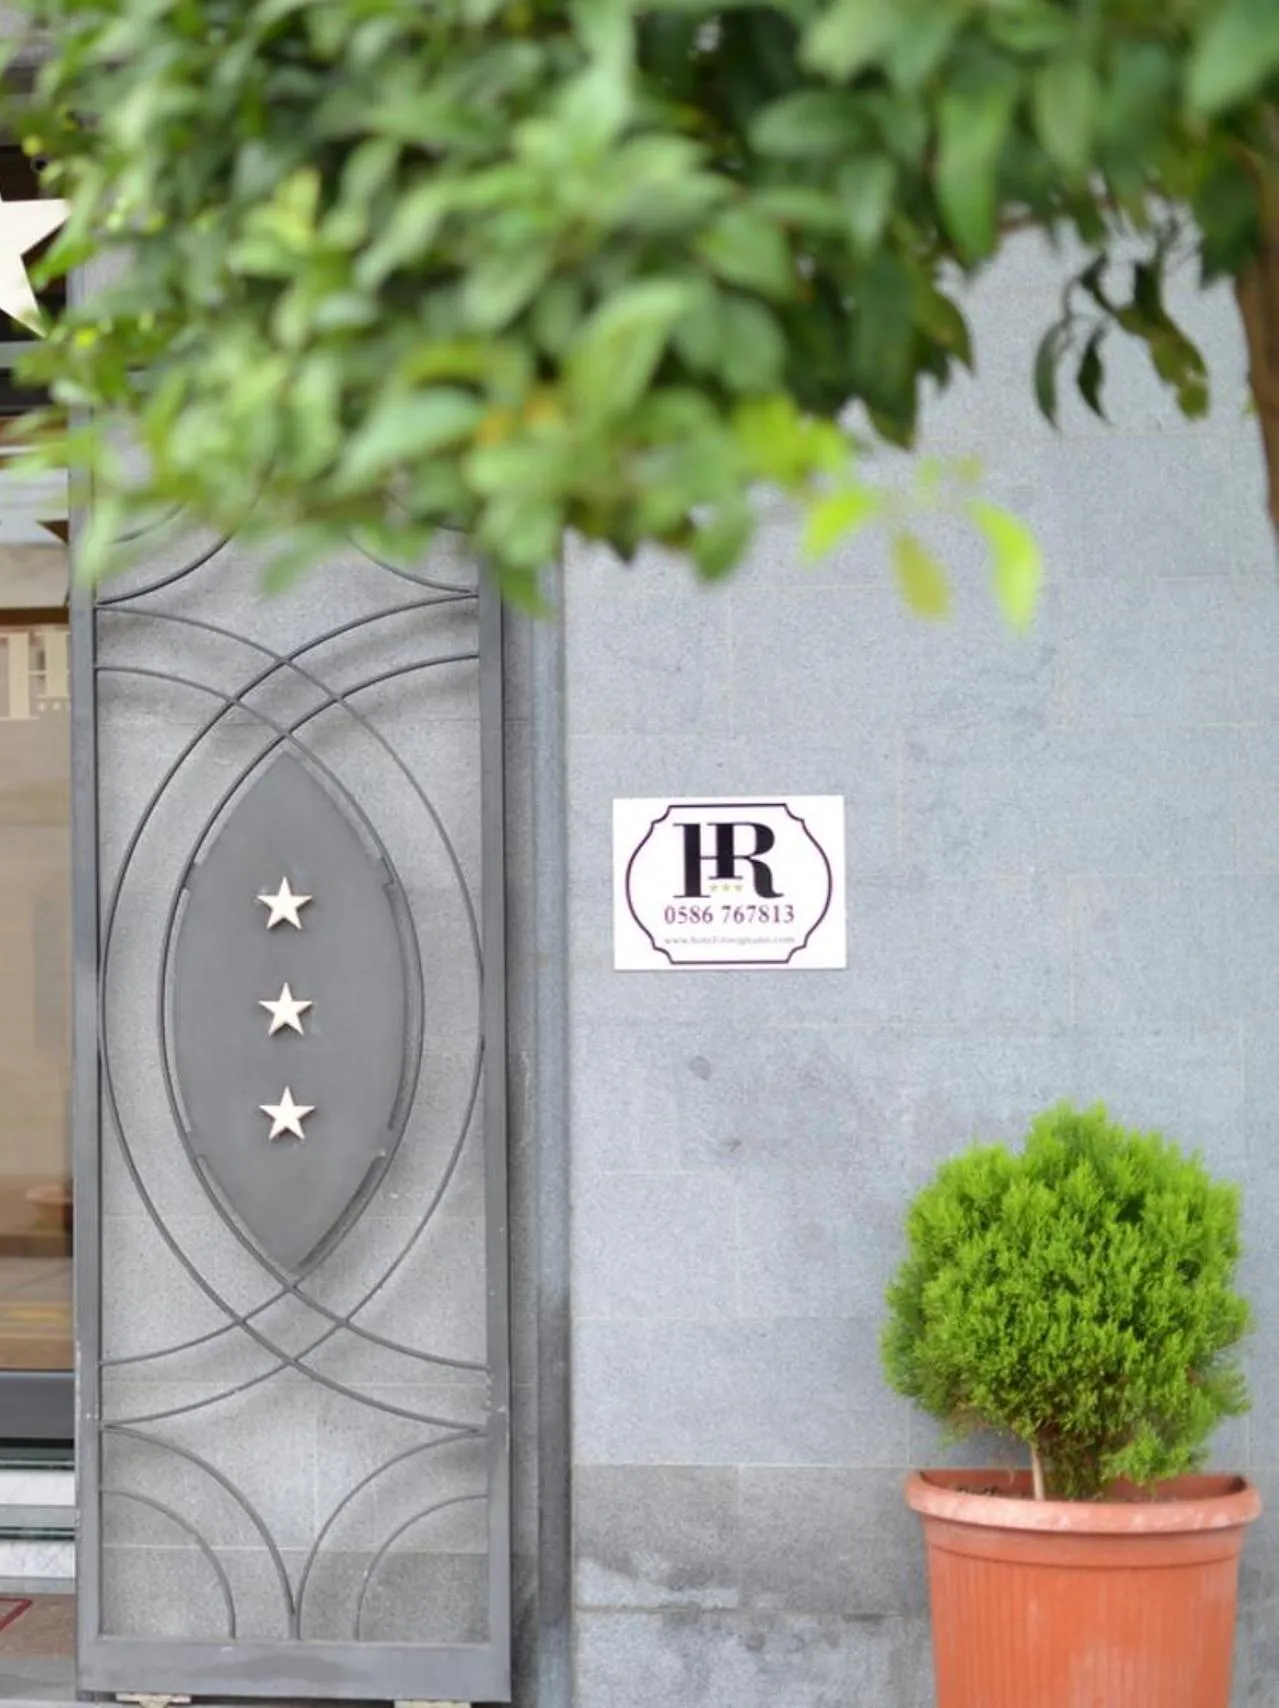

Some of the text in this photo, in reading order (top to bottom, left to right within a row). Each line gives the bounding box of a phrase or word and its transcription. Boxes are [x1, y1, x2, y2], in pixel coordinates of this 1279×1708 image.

[672, 821, 785, 899] HR
[664, 904, 795, 925] 0586 767813
